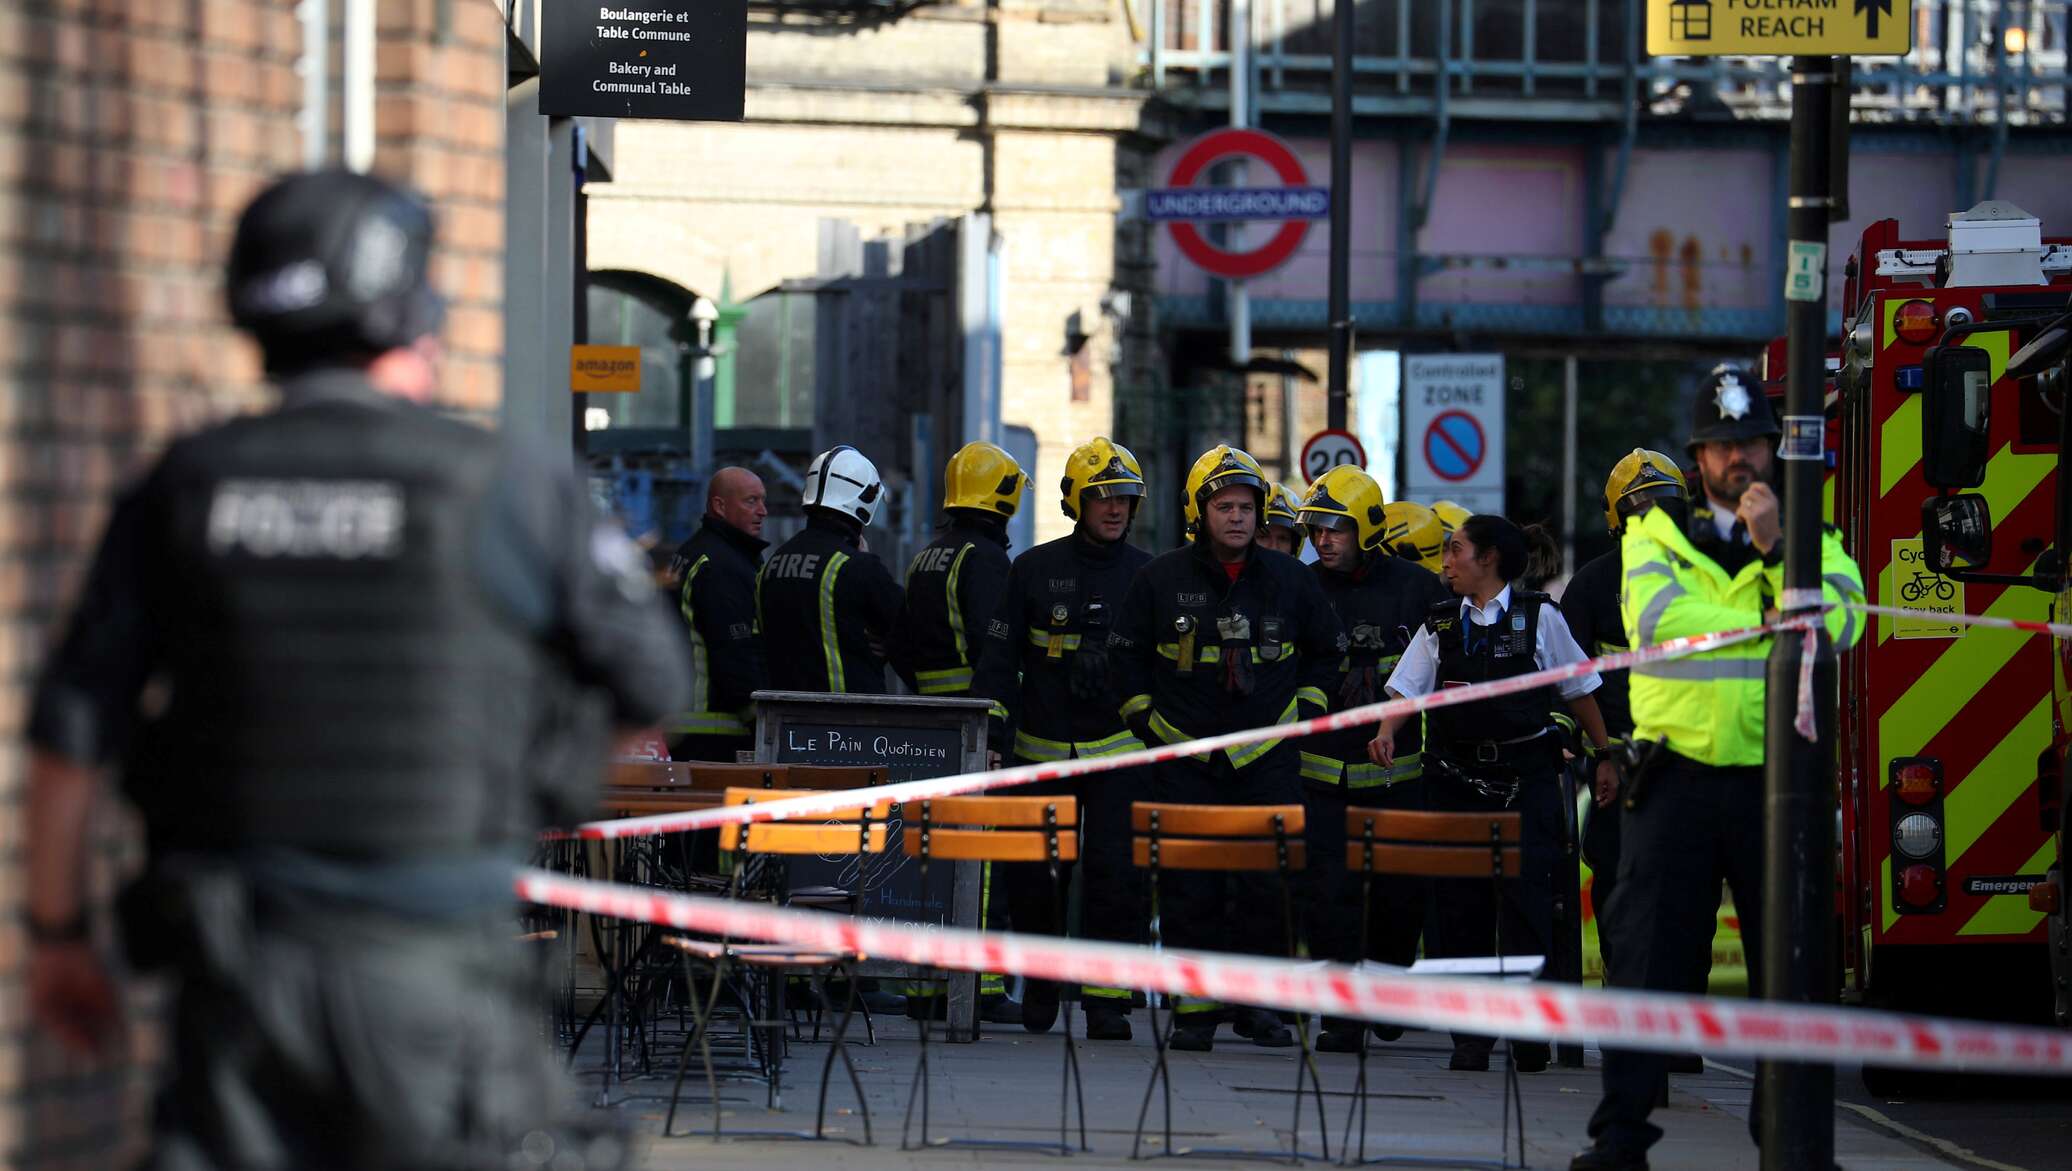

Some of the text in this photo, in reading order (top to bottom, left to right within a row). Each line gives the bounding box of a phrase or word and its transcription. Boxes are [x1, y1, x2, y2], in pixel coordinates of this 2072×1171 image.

[600, 8, 689, 24] Boulangerie et
[597, 26, 691, 41] Table Commune
[1740, 16, 1825, 37] REACH
[609, 62, 676, 77] Bakery and
[593, 80, 691, 95] Communal Table
[1151, 191, 1327, 215] UNDERGROUND
[1411, 361, 1497, 378] Controlled
[1424, 385, 1484, 405] ZONE
[1310, 449, 1356, 476] 20
[765, 553, 821, 579] FIRE
[1929, 604, 1955, 614] back
[1970, 880, 2047, 893] Emergen
